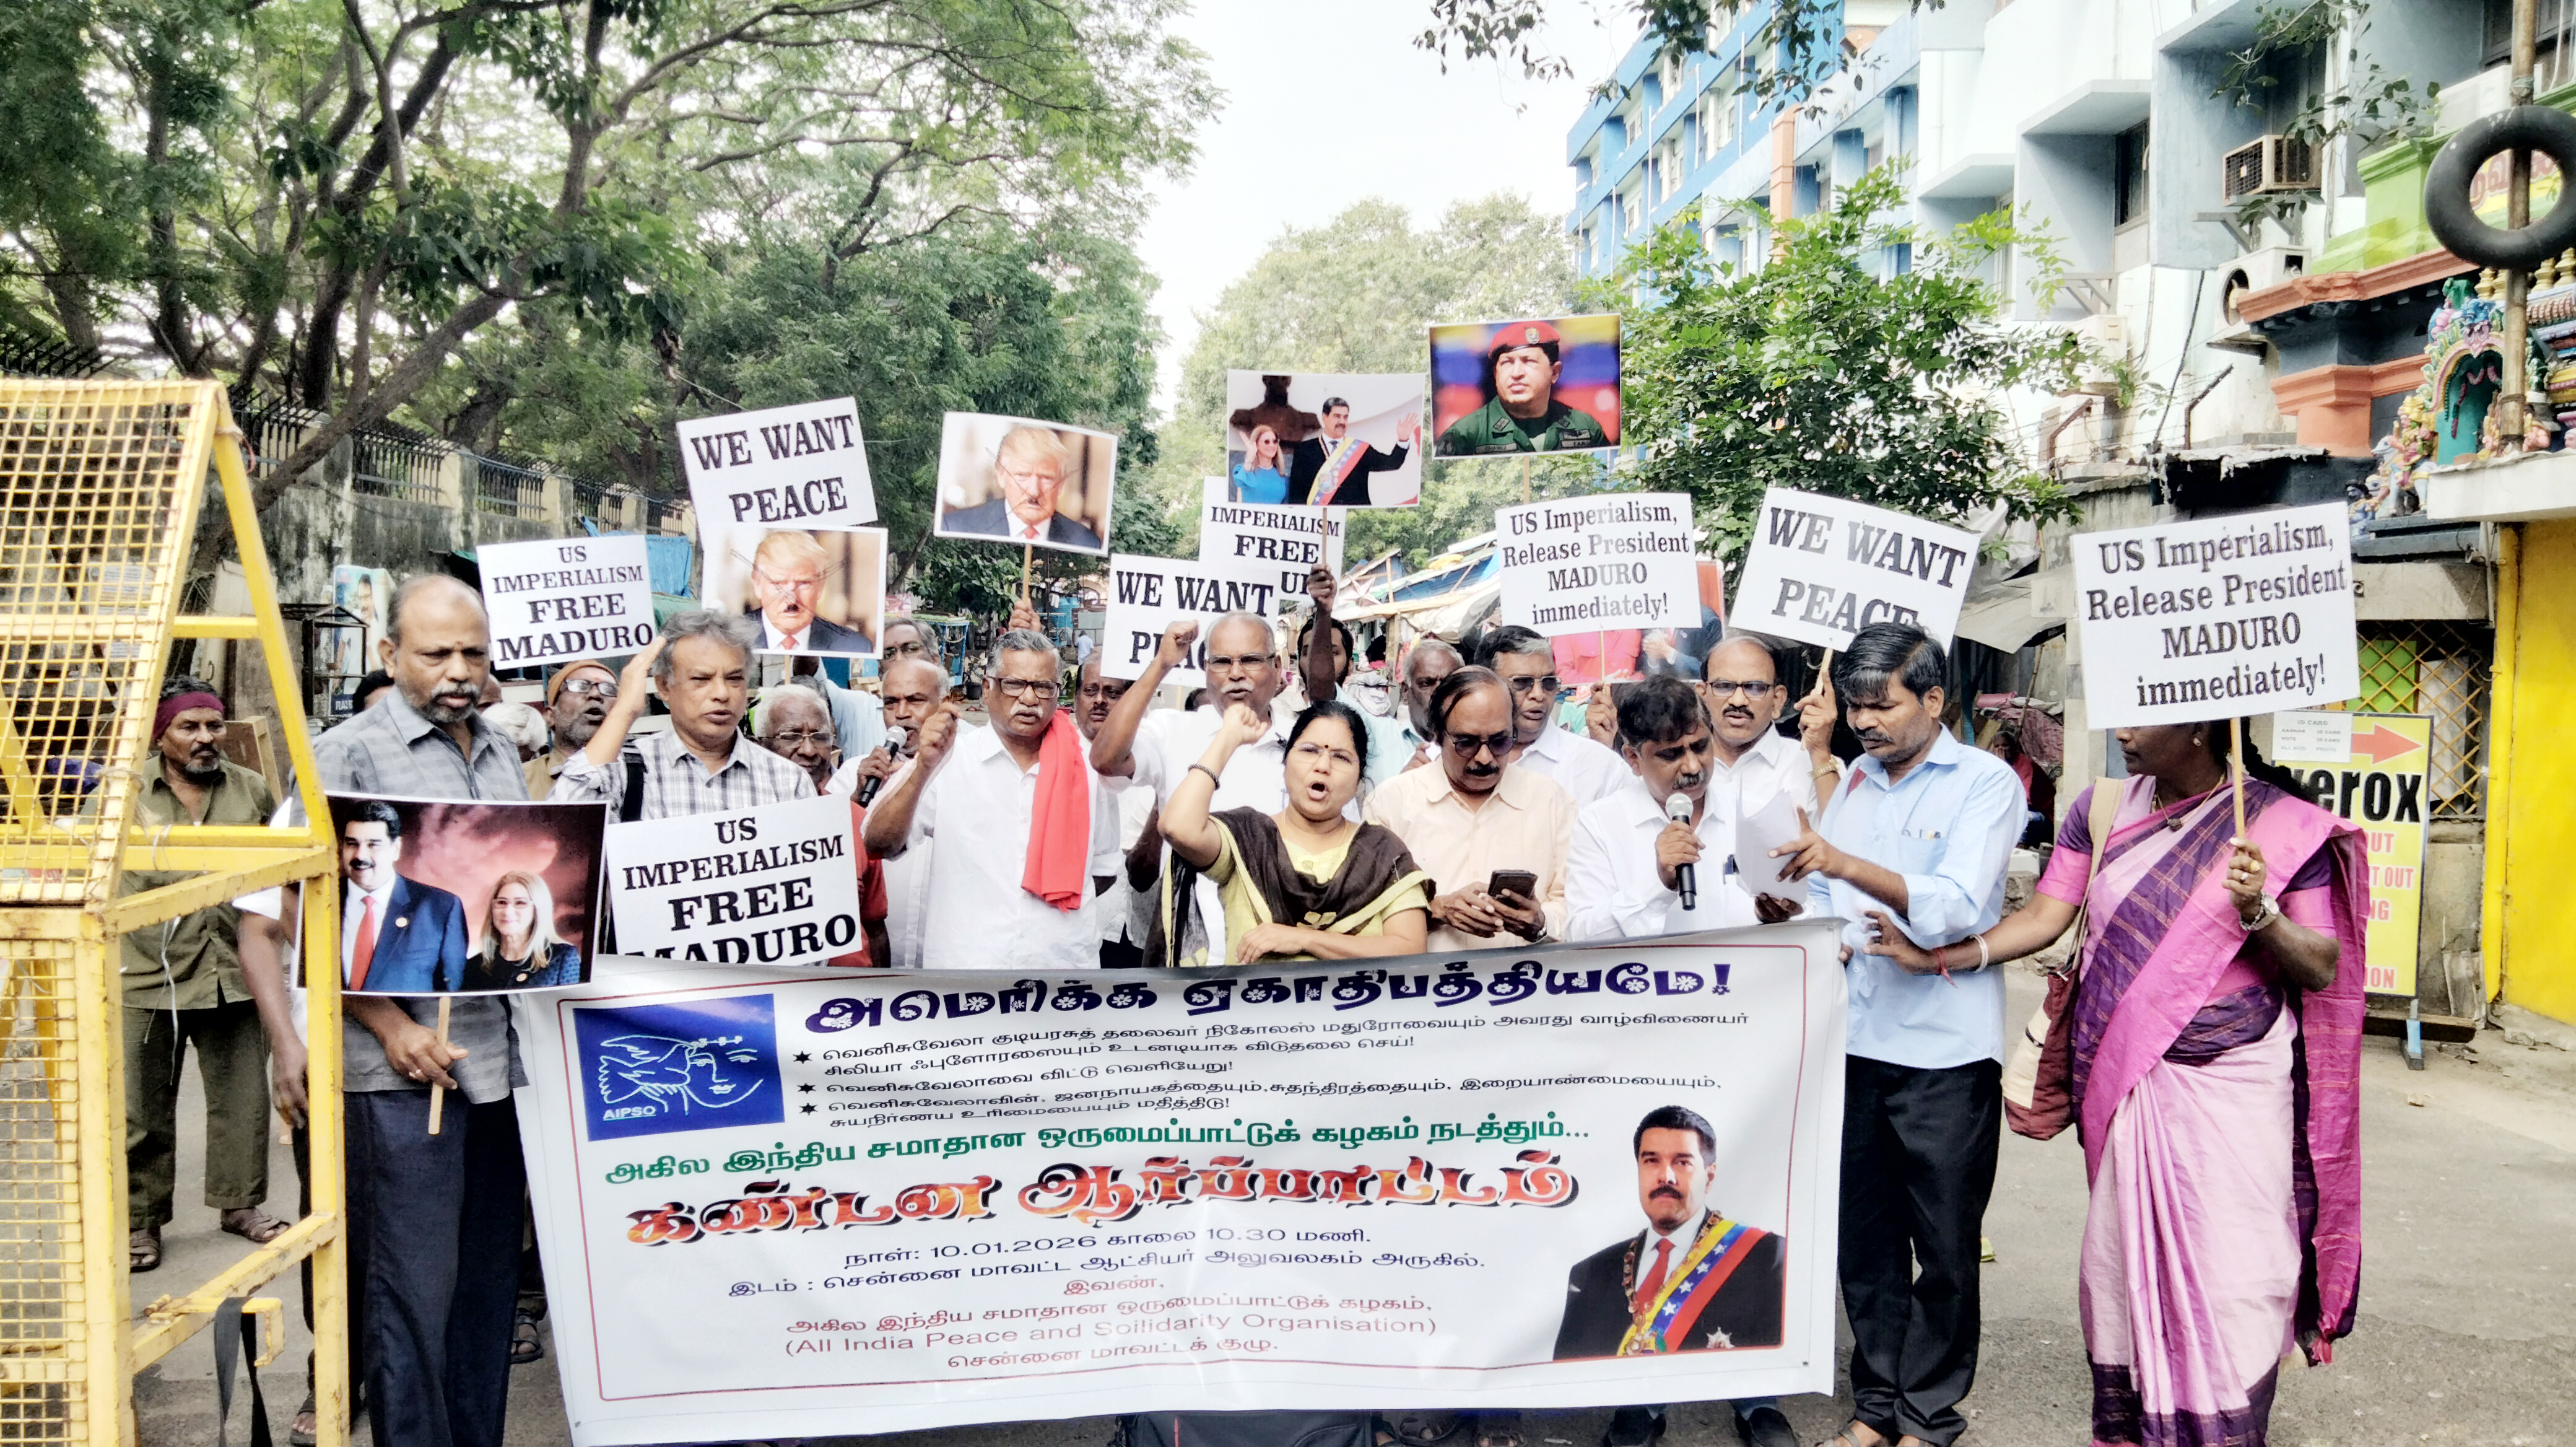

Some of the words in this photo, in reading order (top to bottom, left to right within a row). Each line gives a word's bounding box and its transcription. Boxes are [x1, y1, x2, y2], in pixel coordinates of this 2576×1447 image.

[691, 431, 752, 470] WE
[760, 415, 855, 460] WANT
[729, 478, 848, 522] PEACE
[1510, 511, 1538, 535] US
[1544, 501, 1677, 531] Imperialism,
[1211, 506, 1339, 536] IMPERIALISM
[558, 546, 587, 564] US
[1234, 535, 1319, 564] FREE
[1503, 542, 1581, 567] Release
[1588, 531, 1690, 556] President
[1769, 507, 1834, 554] WE
[1848, 521, 1965, 588] WANT
[2099, 540, 2144, 573] US
[2155, 521, 2334, 572] Imperialism,
[494, 566, 643, 593] IMPERIALISM
[1116, 571, 1163, 607] WE
[1175, 576, 1274, 617] WANT
[1547, 562, 1648, 592] MADURO
[2086, 586, 2212, 621] Release
[2224, 561, 2346, 606] President
[528, 593, 626, 623] FREE
[1531, 592, 1668, 625] immediately!
[498, 623, 653, 662] MADURO
[2162, 612, 2301, 658] MADURO
[2137, 654, 2325, 707] immediately!
[2293, 769, 2422, 823] erox
[715, 817, 757, 844] US
[2366, 832, 2395, 852] UT
[623, 834, 844, 891] IMPERIALISM
[2385, 868, 2414, 888] OUT
[668, 877, 814, 931] FREE
[805, 979, 1157, 1034] அமெரிக்க
[1183, 960, 1731, 1016] ஏகாதிபத்தியமே!
[823, 1036, 985, 1060] வெனிசுவேலா
[991, 1028, 1096, 1045] குடியரசுத்
[1102, 1025, 1198, 1040] தலைவர்
[1206, 1021, 1315, 1039] நிகோலஸ்
[1323, 1016, 1486, 1034] மதுரோவையும்
[1493, 1015, 1572, 1028] அவரது
[1580, 1012, 1749, 1027] வாழ்விணையர்
[824, 1063, 903, 1076] சிலியா
[1108, 1044, 1237, 1053] உடனடியாக
[1245, 1040, 1351, 1053] விடுதலை
[1358, 1036, 1414, 1049] செய்!
[827, 1073, 1033, 1093] வெனிசுவேலாவை
[1040, 1065, 1098, 1080] விட்டு
[1106, 1060, 1233, 1075] வெளியேறு!
[829, 1093, 1046, 1111] வெனிசுவேலாவின்,
[1460, 1074, 1721, 1091] இறையாண்மையையும்,
[603, 1105, 656, 1120] AIPSO
[830, 1113, 954, 1128] சுயநிர்ணய
[961, 1100, 1130, 1117] உரிமையையும்
[1138, 1096, 1229, 1111] மதித்திடு!
[605, 1155, 710, 1185] அகில
[722, 1142, 855, 1174] இந்திய
[868, 1132, 1026, 1160] சமாதான
[1037, 1117, 1301, 1148] ஒருமைப்பாட்டுக்
[1312, 1115, 1419, 1150] கழகம்
[1427, 1111, 1588, 1144] நடத்தும்...
[625, 1175, 1003, 1246] கண்டன
[1017, 1149, 1579, 1228] ஆர்ப்பாட்டம்
[844, 1248, 920, 1270] நாள்:
[931, 1236, 1097, 1257] 10.01.2026
[1107, 1230, 1196, 1246] காலை
[1206, 1228, 1286, 1241] 10.30
[1297, 1229, 1371, 1242] மணி.
[728, 1279, 797, 1296] இடம்
[824, 1269, 961, 1290] சென்னை
[972, 1260, 1071, 1277] மாவட்ட
[1081, 1249, 1195, 1271] ஆட்சியர்
[1204, 1250, 1362, 1268] அலுவலகம்
[1372, 1252, 1485, 1269] அருகில்.
[1063, 1275, 1164, 1295] இவண்,
[786, 1318, 866, 1333] அகில
[876, 1310, 972, 1332] இந்திய
[983, 1303, 1107, 1322] சமாதான
[1116, 1293, 1329, 1314] ஒருமைப்பாட்டுக்
[1339, 1295, 1432, 1313] கழகம்,
[785, 1340, 831, 1357] (All
[845, 1336, 913, 1351] India
[926, 1330, 1018, 1348] Peace
[1030, 1324, 1082, 1340] and
[1243, 1314, 1437, 1336] Organisation)
[947, 1351, 1081, 1368] சென்னை
[1090, 1336, 1207, 1359] மாவட்டக்
[1216, 1338, 1278, 1352] குழு.
